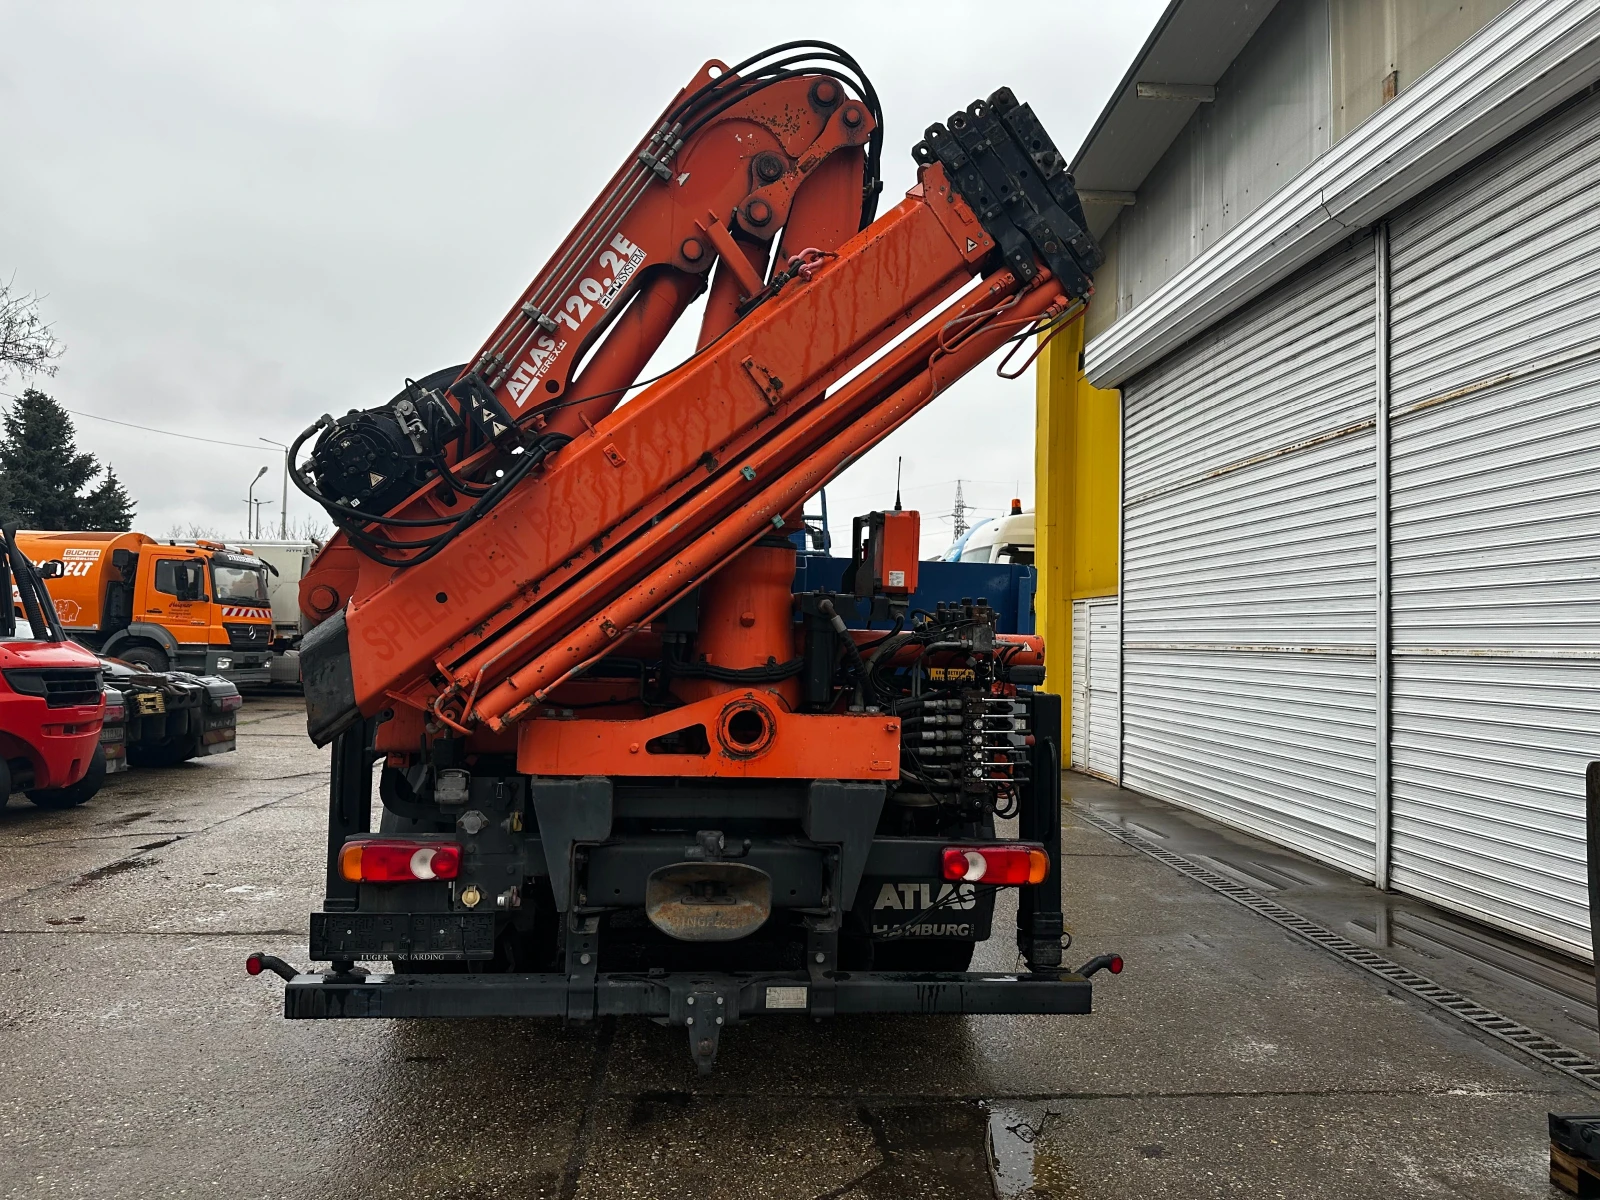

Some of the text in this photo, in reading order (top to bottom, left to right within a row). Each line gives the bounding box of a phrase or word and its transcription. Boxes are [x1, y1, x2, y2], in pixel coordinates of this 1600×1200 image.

[504, 335, 556, 401] ATLAS
[536, 349, 560, 378] TEREX
[361, 526, 530, 660] SPIELHAGEN
[210, 719, 231, 728] MAN
[873, 883, 976, 910] ATLAS
[872, 923, 970, 937] HAMBURG
